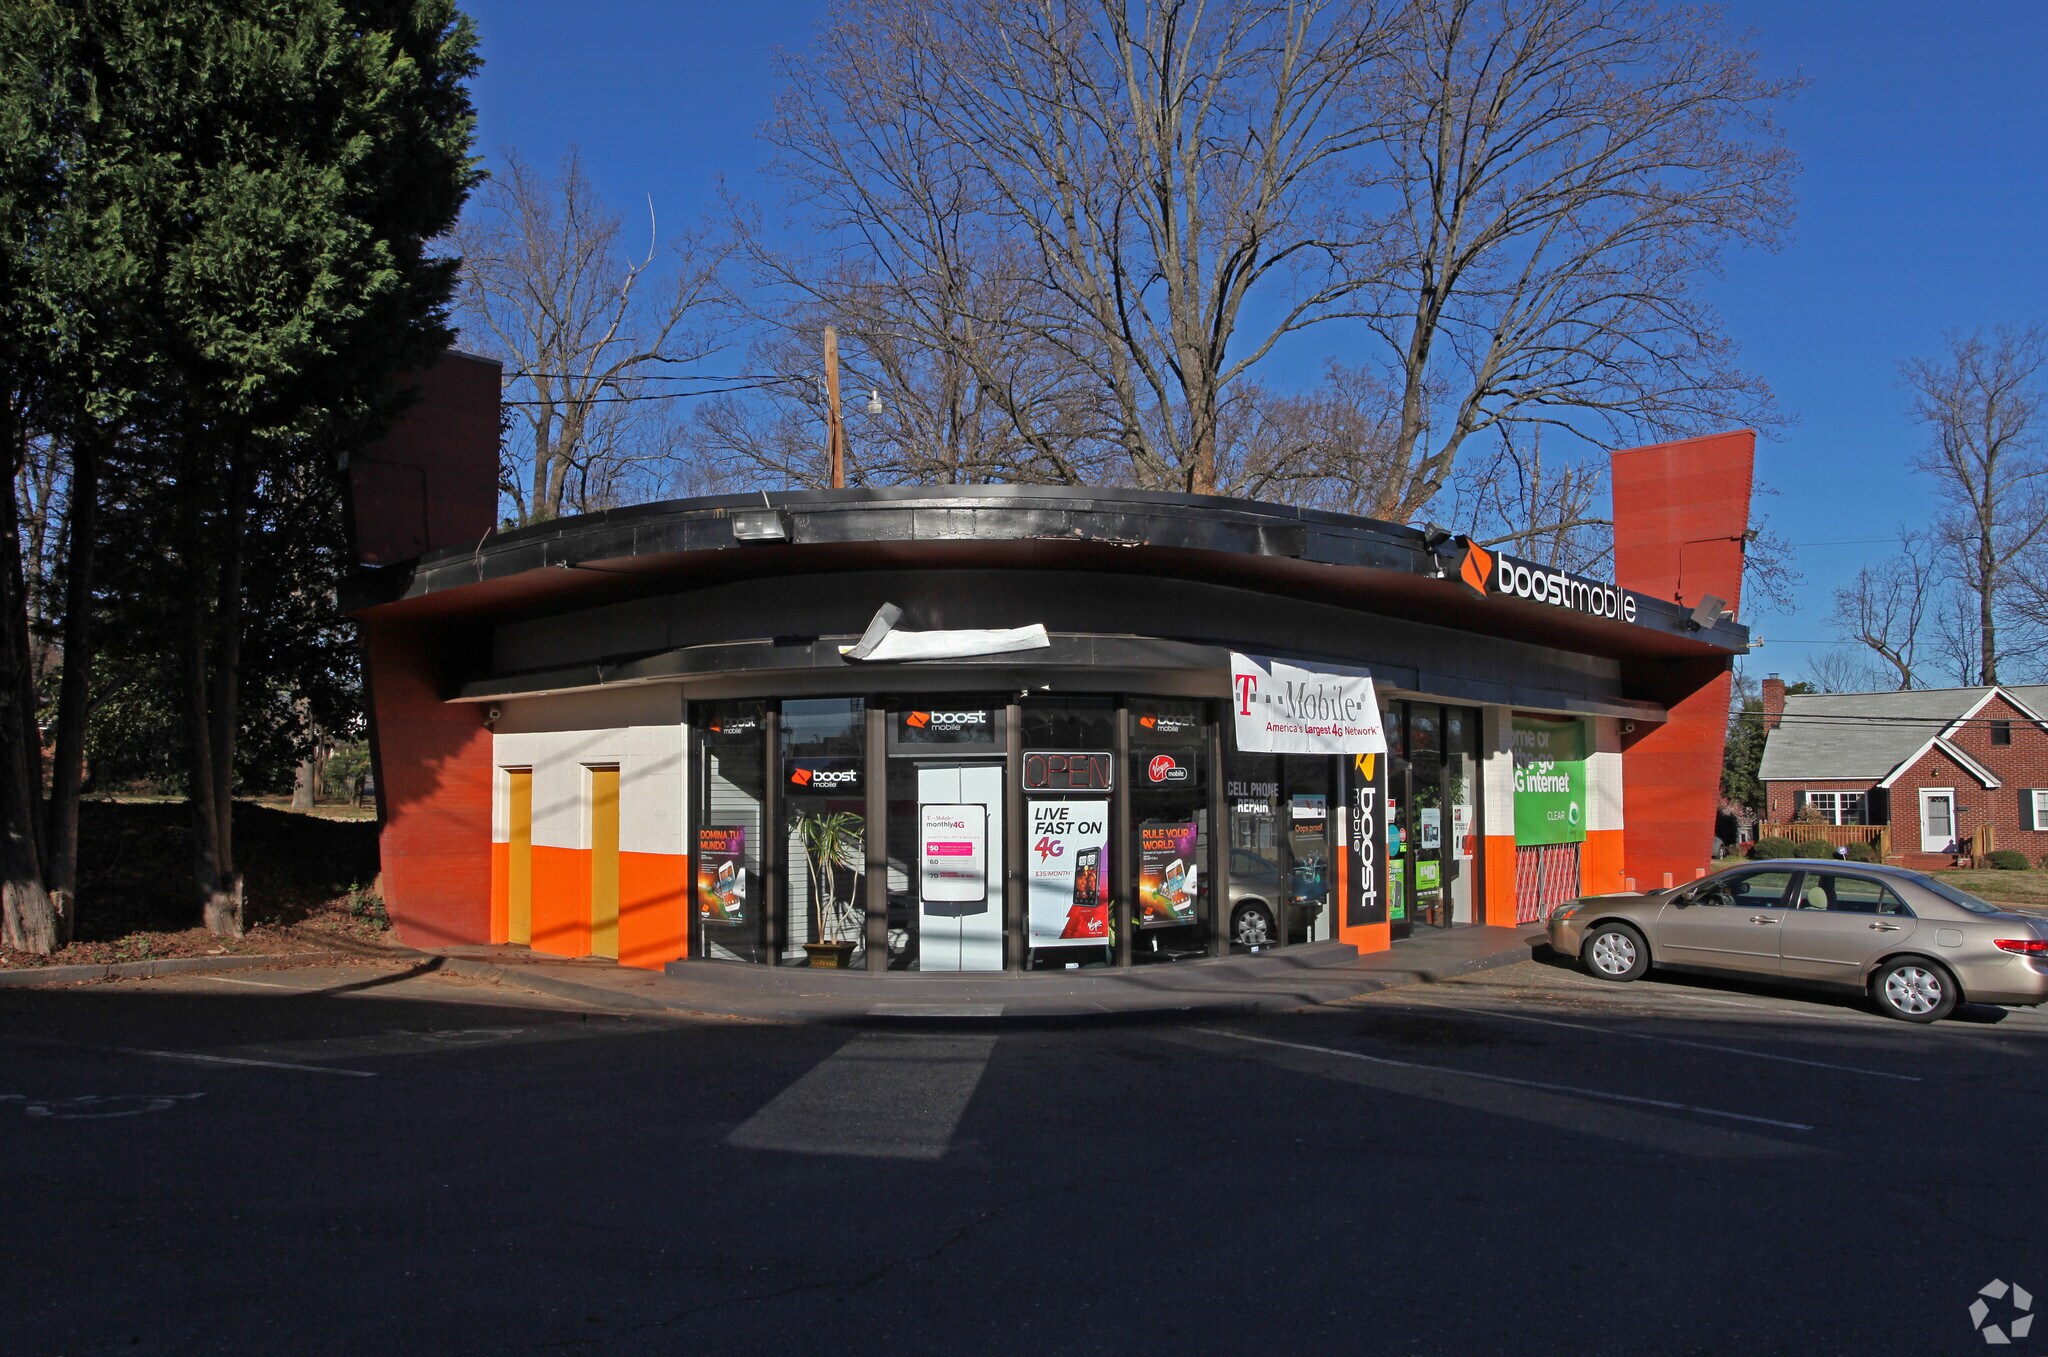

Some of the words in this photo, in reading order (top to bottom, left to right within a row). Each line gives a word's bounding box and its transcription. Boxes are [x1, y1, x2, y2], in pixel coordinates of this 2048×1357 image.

[931, 710, 986, 724] boost
[1157, 713, 1195, 727] boost
[931, 723, 961, 731] mobile
[1265, 721, 1303, 733] America's
[1305, 723, 1331, 736] Largest
[1331, 723, 1343, 737] 4G
[1538, 731, 1550, 748] or
[812, 769, 857, 782] boost
[1026, 755, 1110, 788] OPEN
[1513, 769, 1525, 793] G
[1526, 769, 1570, 793] internet
[1227, 781, 1249, 797] CELL
[1250, 782, 1279, 797] PHONE
[1237, 799, 1269, 814] REPAIR
[1034, 807, 1070, 821] LIVE
[1353, 788, 1361, 852] mobile
[1546, 810, 1566, 821] CLEAR
[700, 830, 728, 839] DOMINA
[728, 830, 739, 839] TU
[1034, 822, 1075, 835] FAST
[1077, 821, 1103, 835] ON
[1142, 829, 1165, 839] RULE
[1165, 828, 1189, 838] YOUR
[1295, 824, 1309, 833] Oops
[1034, 837, 1064, 863] 4G
[1361, 787, 1377, 907] boost
